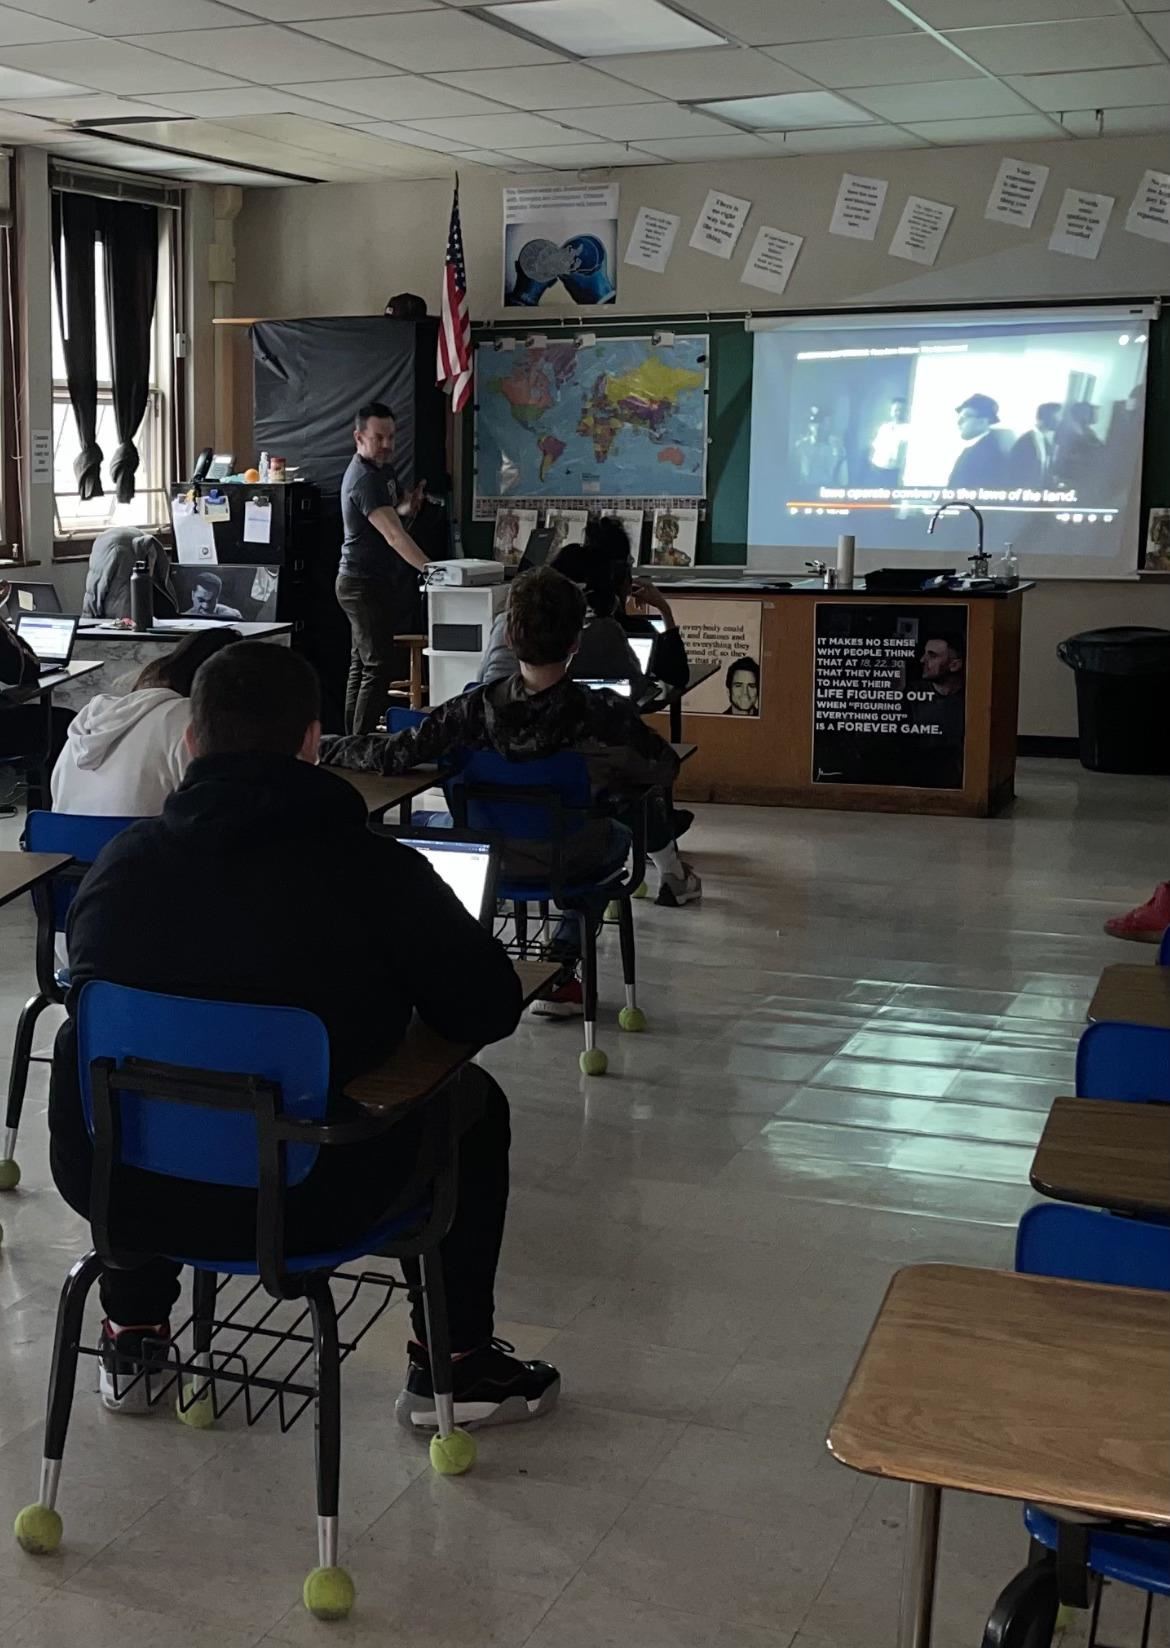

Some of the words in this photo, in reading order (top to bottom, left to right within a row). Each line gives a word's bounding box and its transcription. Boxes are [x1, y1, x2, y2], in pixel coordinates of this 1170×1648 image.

[683, 624, 720, 632] everybody
[693, 641, 732, 649] everything
[734, 642, 749, 650] they
[829, 638, 863, 646] MAKES
[883, 639, 916, 647] SENSE
[817, 648, 841, 656] WHY
[844, 649, 882, 657] PEOPLE
[885, 649, 915, 657] THINK
[845, 659, 858, 667] AT
[817, 669, 842, 677] THAT
[845, 669, 871, 677] THEY
[874, 670, 900, 678] HAVE
[817, 679, 830, 687] TO
[862, 680, 891, 688] THEIR
[817, 689, 843, 699] LIFE
[847, 690, 903, 700] FIGURED
[907, 691, 935, 702] OUT
[817, 701, 846, 709] WHEN
[816, 711, 878, 721] EVERYTHING
[827, 723, 834, 731] A
[837, 722, 897, 733] FOREVER
[901, 724, 942, 735] GAME.
